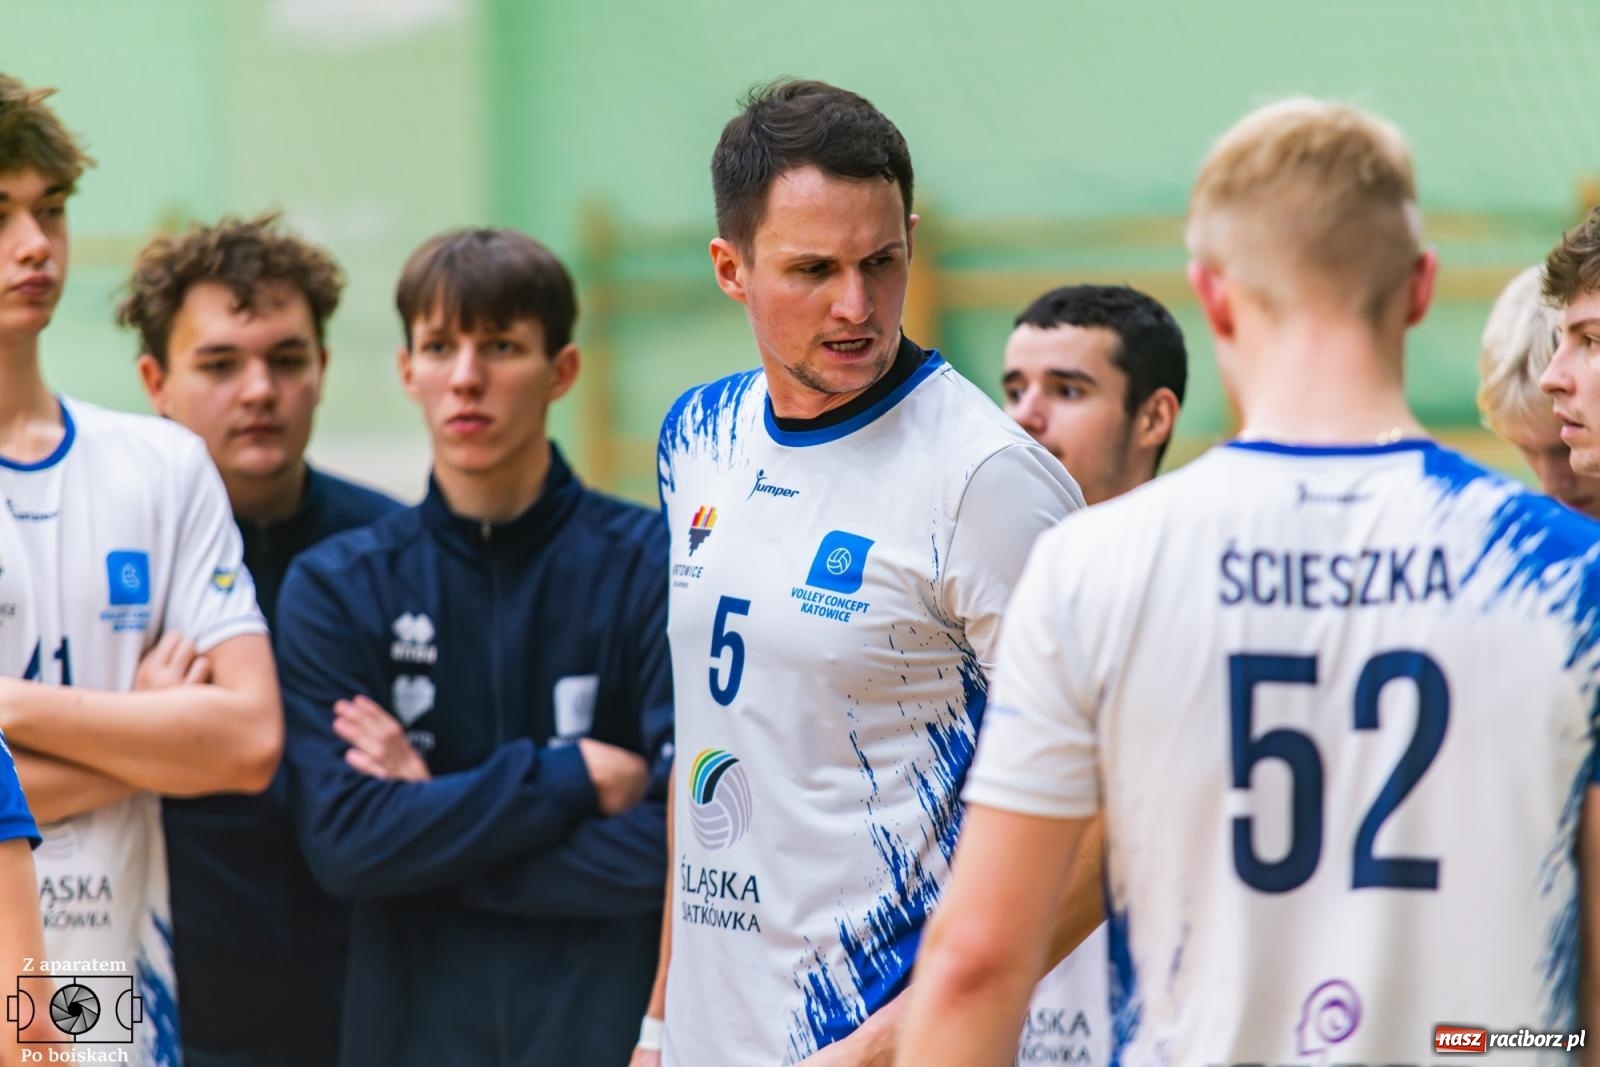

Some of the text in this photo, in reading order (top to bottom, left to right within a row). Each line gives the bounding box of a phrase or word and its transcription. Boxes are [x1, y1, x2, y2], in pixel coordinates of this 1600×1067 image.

[1219, 537, 1455, 609] ŚCIESZKA
[791, 587, 870, 613] VOLLEY CONCEPT
[800, 602, 851, 622] KATOWICE
[709, 595, 752, 706] 5
[1227, 649, 1451, 894] 52
[39, 875, 113, 908] ĄSKA
[681, 854, 761, 903] ŚLĄSKA
